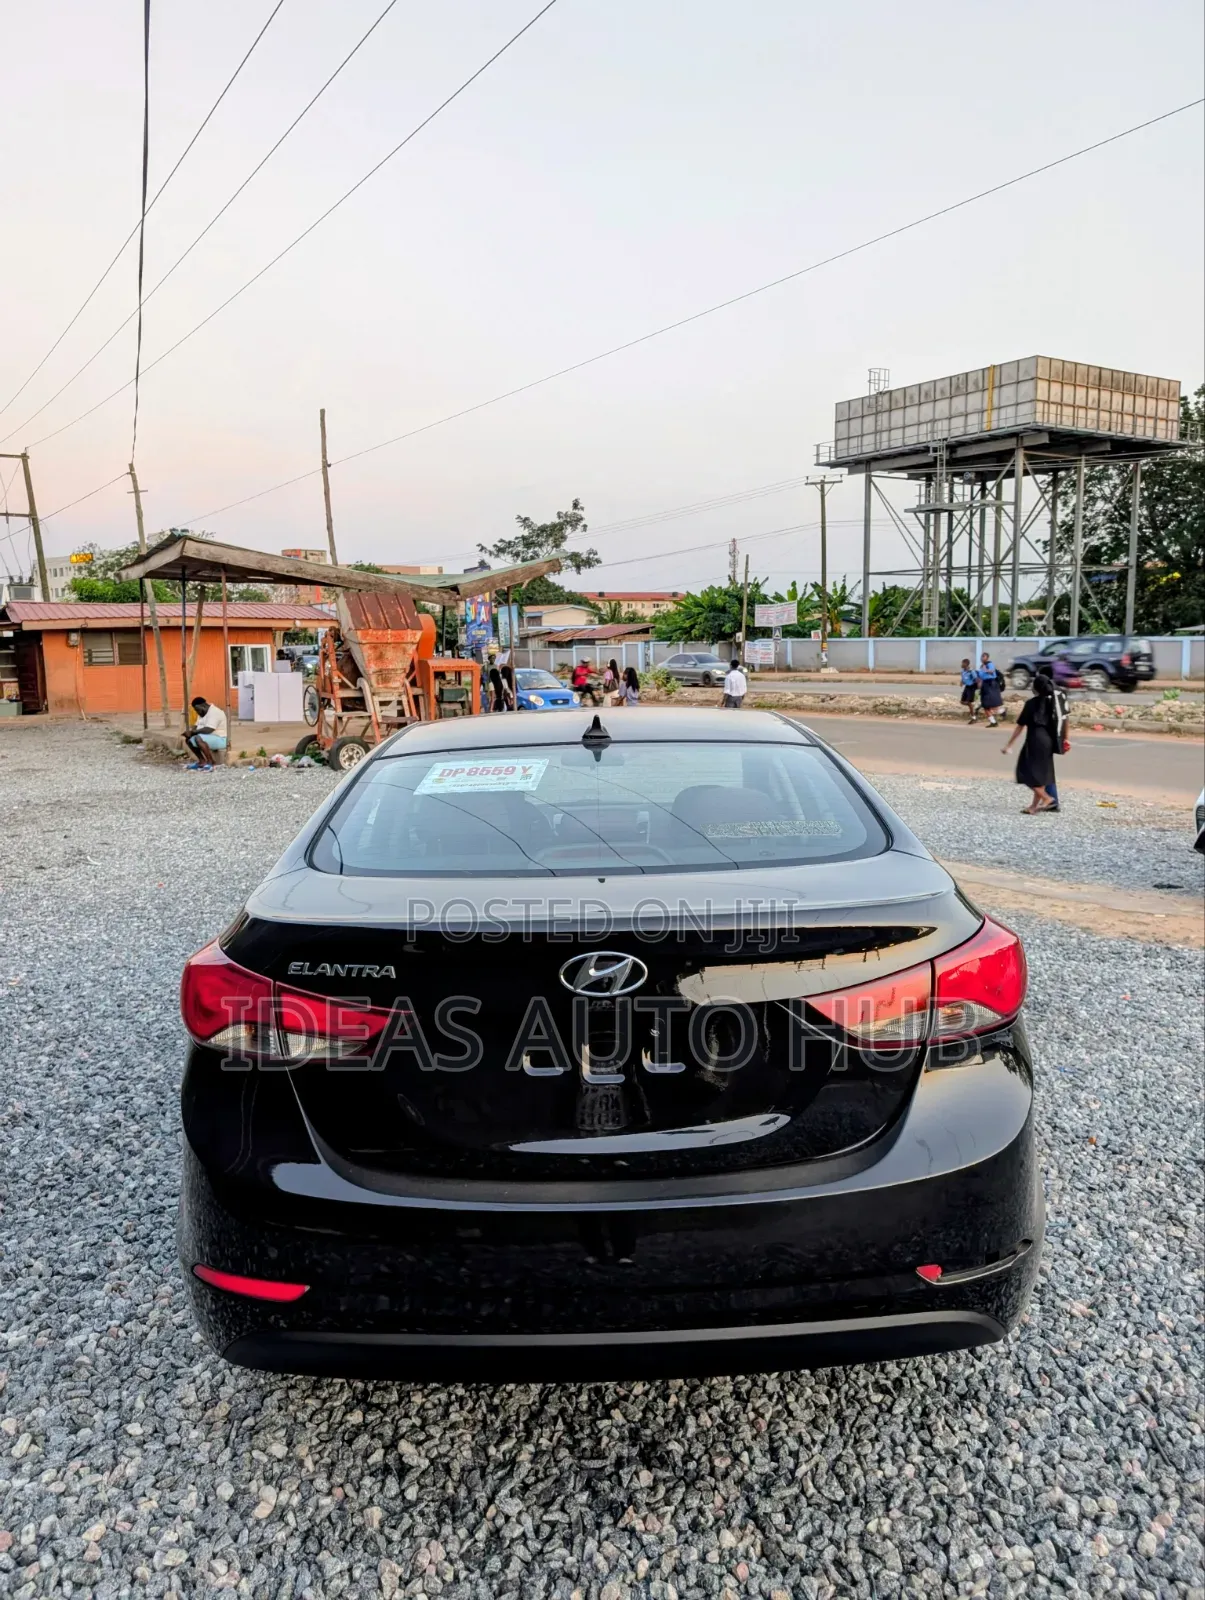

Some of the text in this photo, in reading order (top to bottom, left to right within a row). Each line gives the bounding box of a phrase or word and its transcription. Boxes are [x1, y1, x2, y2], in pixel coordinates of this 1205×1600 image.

[439, 765, 533, 778] DP 8559 Y
[287, 961, 397, 979] ELANTRA
